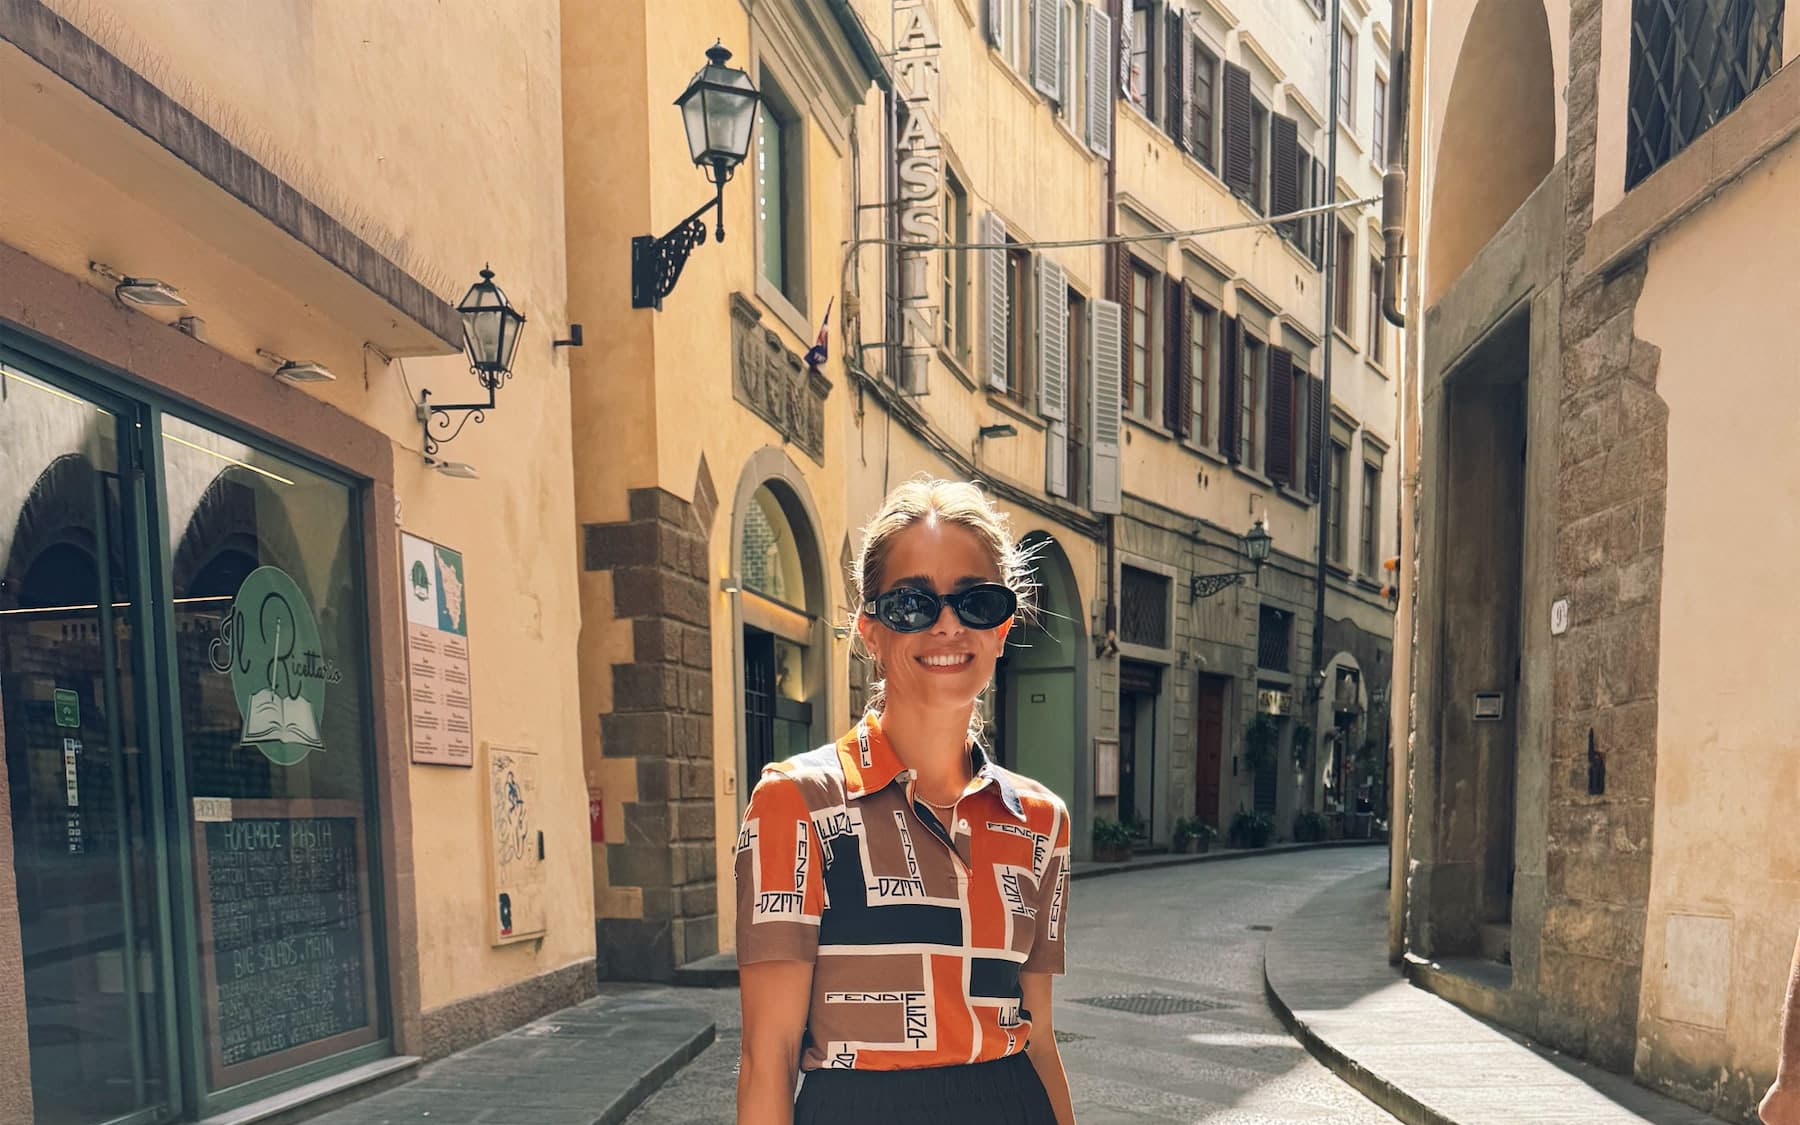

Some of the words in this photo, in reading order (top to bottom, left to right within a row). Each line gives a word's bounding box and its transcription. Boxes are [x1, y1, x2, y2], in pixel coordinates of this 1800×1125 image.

[899, 0, 942, 397] ATASSINI
[209, 605, 250, 674] Il
[260, 592, 341, 700] Ricettario
[224, 822, 281, 849] HOMEMADE
[290, 820, 332, 848] PASTA
[796, 822, 807, 893] FENDI
[896, 812, 920, 879] FENDI
[1050, 873, 1063, 938] FENDI
[233, 947, 255, 978] BIG
[259, 938, 297, 970] SALADS
[827, 993, 903, 1001] FENDI
[905, 993, 927, 1048] FENDI
